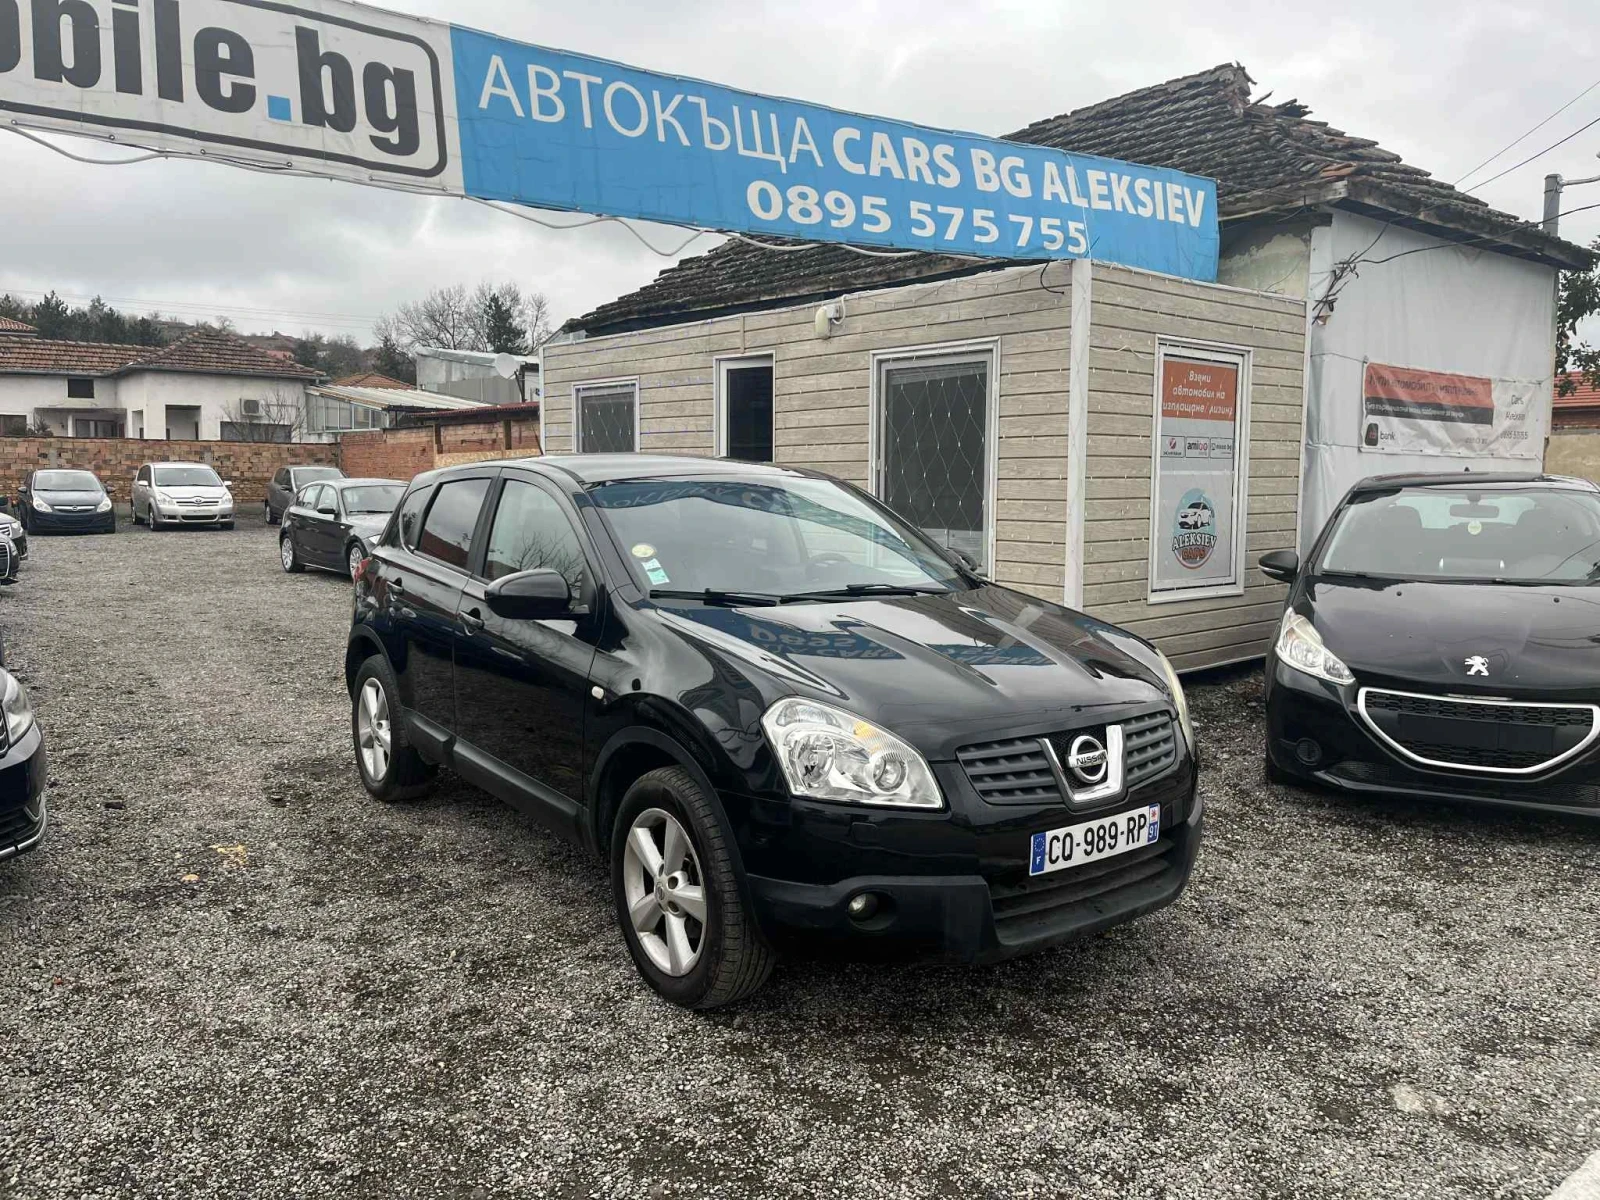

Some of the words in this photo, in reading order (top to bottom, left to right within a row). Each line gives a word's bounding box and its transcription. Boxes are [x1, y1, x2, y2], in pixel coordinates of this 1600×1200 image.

[478, 54, 824, 174] АВТОКЪЩА
[832, 127, 961, 189] CARS
[970, 148, 1032, 198] BG
[1042, 163, 1205, 229] ALEKSIEV
[746, 180, 892, 233] 0895
[910, 203, 1000, 243] 575
[1008, 214, 1088, 254] 755
[1172, 532, 1217, 551] ALEKSIEV
[1076, 751, 1107, 765] NISSAN
[1048, 813, 1147, 865] CQ-989-RP
